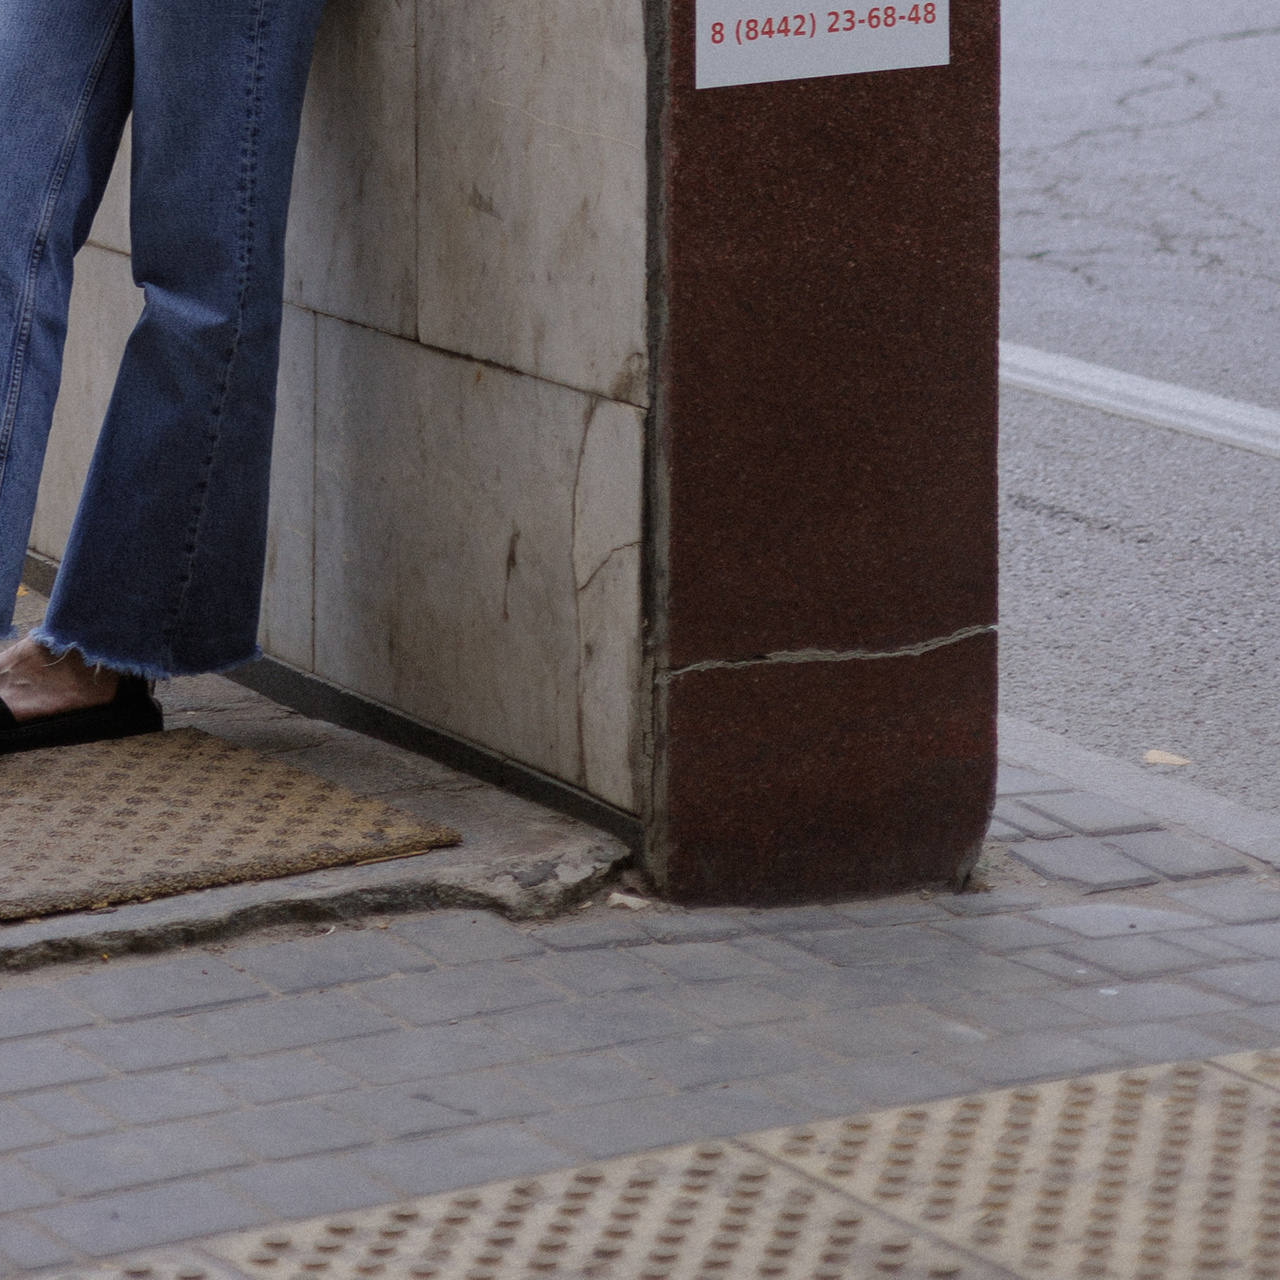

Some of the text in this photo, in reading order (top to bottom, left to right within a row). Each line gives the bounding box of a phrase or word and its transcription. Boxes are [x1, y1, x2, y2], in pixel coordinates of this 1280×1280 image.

[710, 2, 937, 45] 8 (8442) 23-68-48
